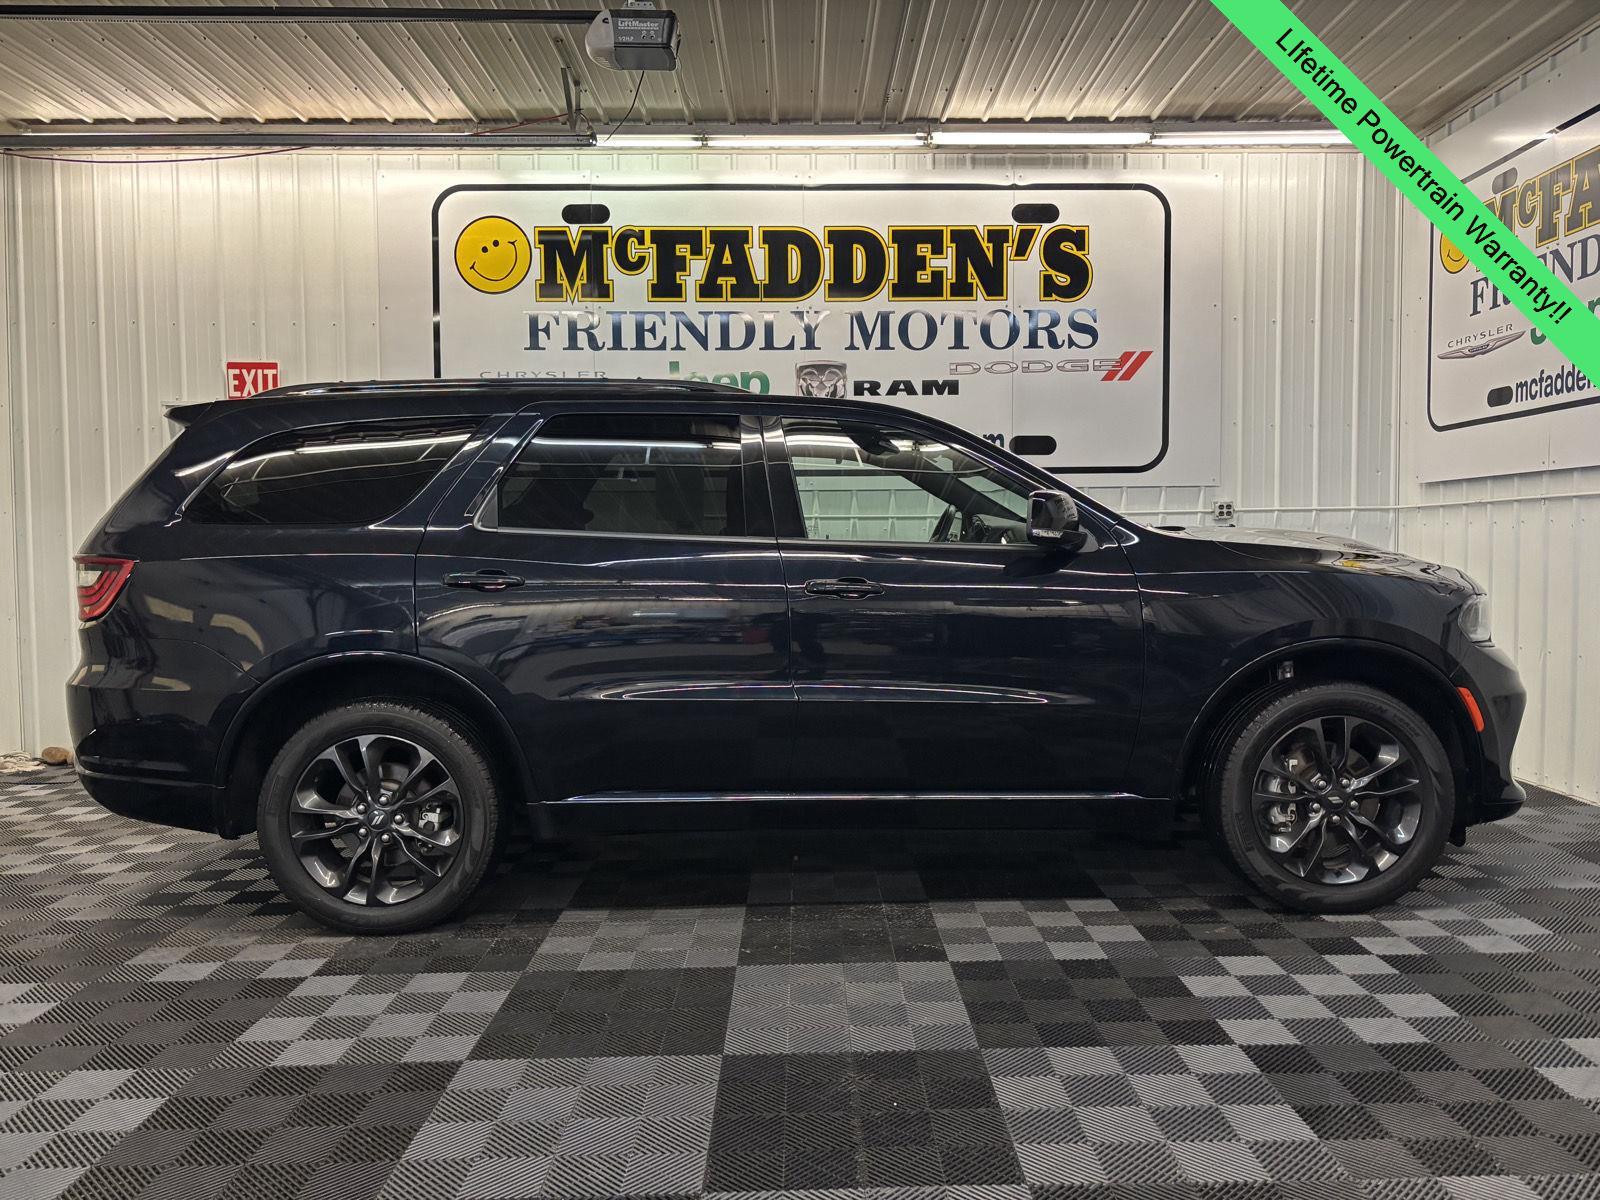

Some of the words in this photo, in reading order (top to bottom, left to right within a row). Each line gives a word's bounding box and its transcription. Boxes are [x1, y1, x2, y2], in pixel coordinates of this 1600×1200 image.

[523, 310, 831, 351] FRIENDLY
[845, 309, 1099, 351] MOTORS
[1447, 323, 1513, 348] CHRYSLER
[949, 358, 1123, 376] DODGE
[227, 368, 277, 397] EXIT
[853, 379, 960, 396] RAM
